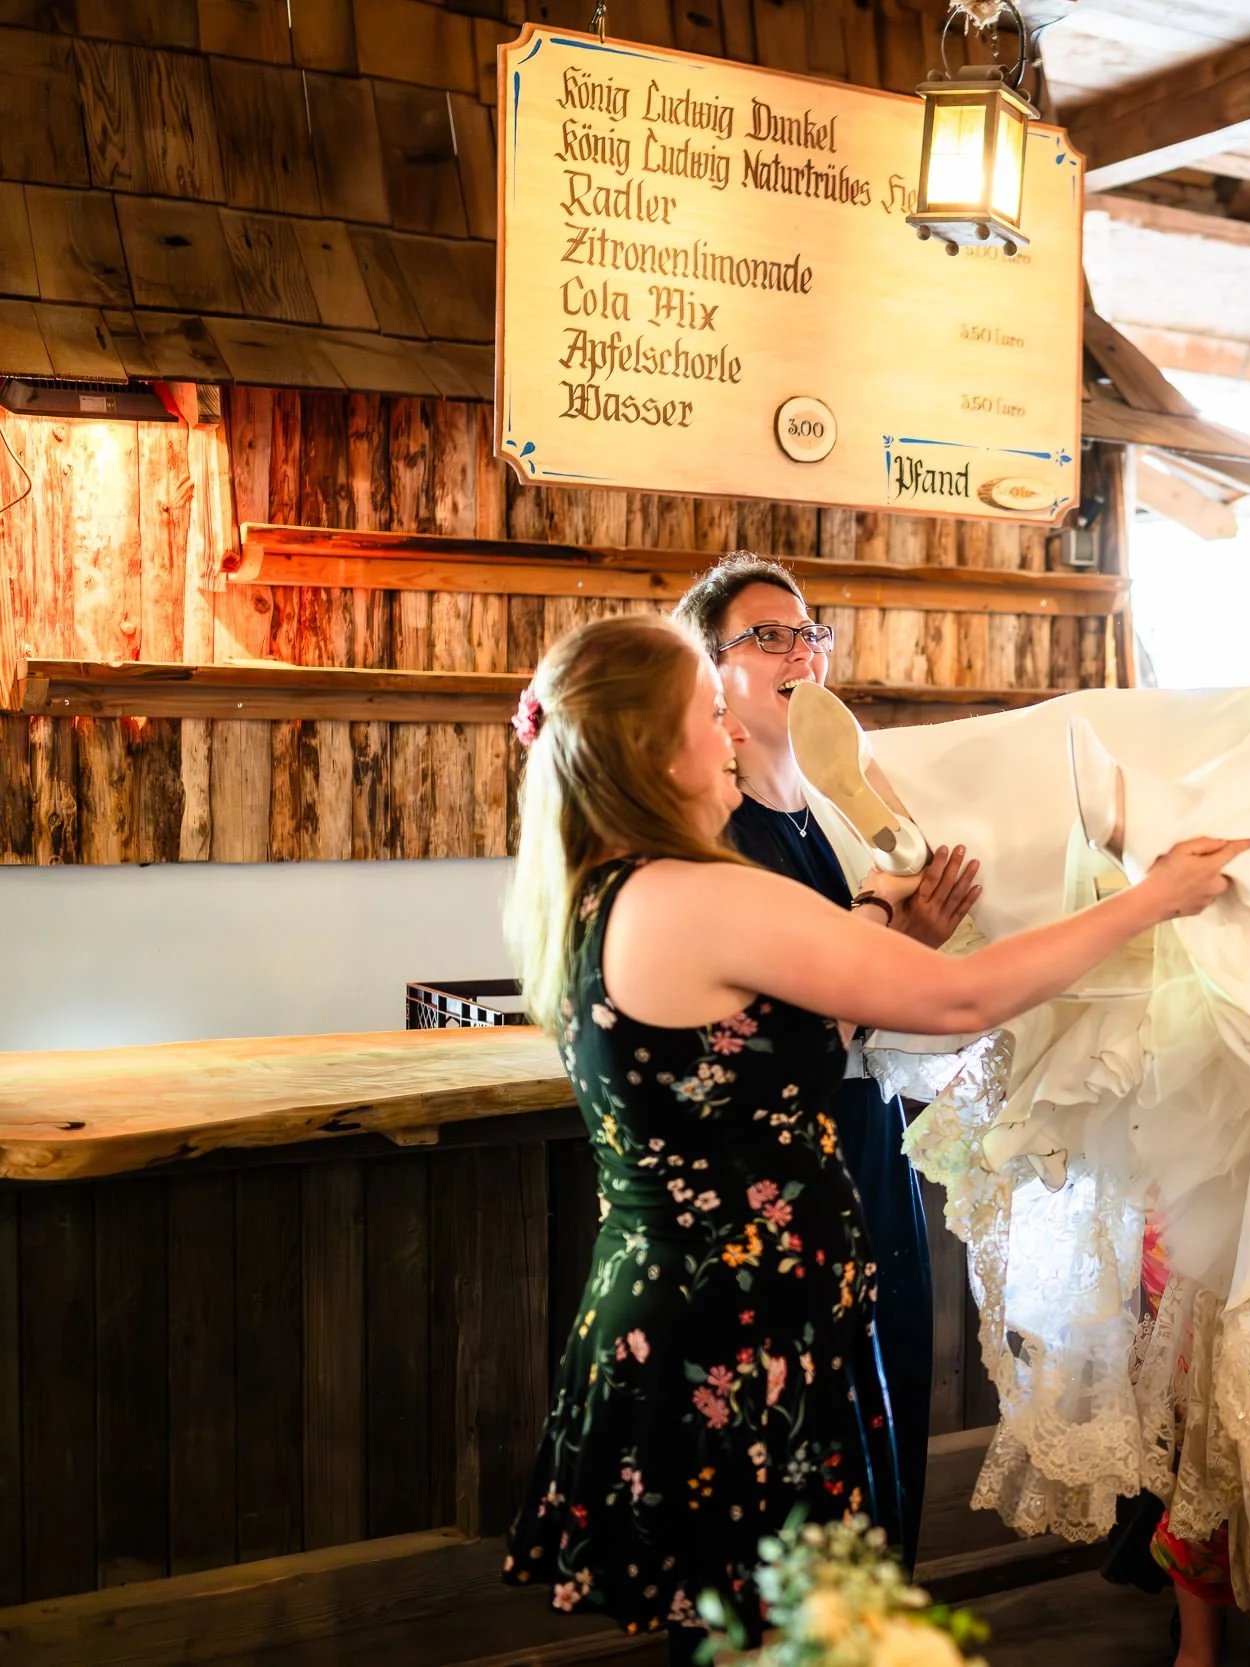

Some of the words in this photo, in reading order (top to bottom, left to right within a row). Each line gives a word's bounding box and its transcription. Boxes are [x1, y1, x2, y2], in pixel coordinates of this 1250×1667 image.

[556, 66, 630, 122] König
[642, 80, 734, 140] Ludwig
[745, 97, 839, 153] Dunkel
[554, 118, 631, 176] König
[642, 128, 731, 191] Ludwig
[742, 149, 872, 207] Naturtrübes
[560, 170, 677, 225] Radler
[560, 222, 813, 295] Zitronenlimonade
[560, 276, 631, 321] Cola
[648, 285, 719, 332] Mix
[559, 328, 742, 383] Apfelschorle
[559, 380, 694, 428] Wasser
[788, 418, 825, 438] 3,00
[894, 455, 970, 500] Pfand
